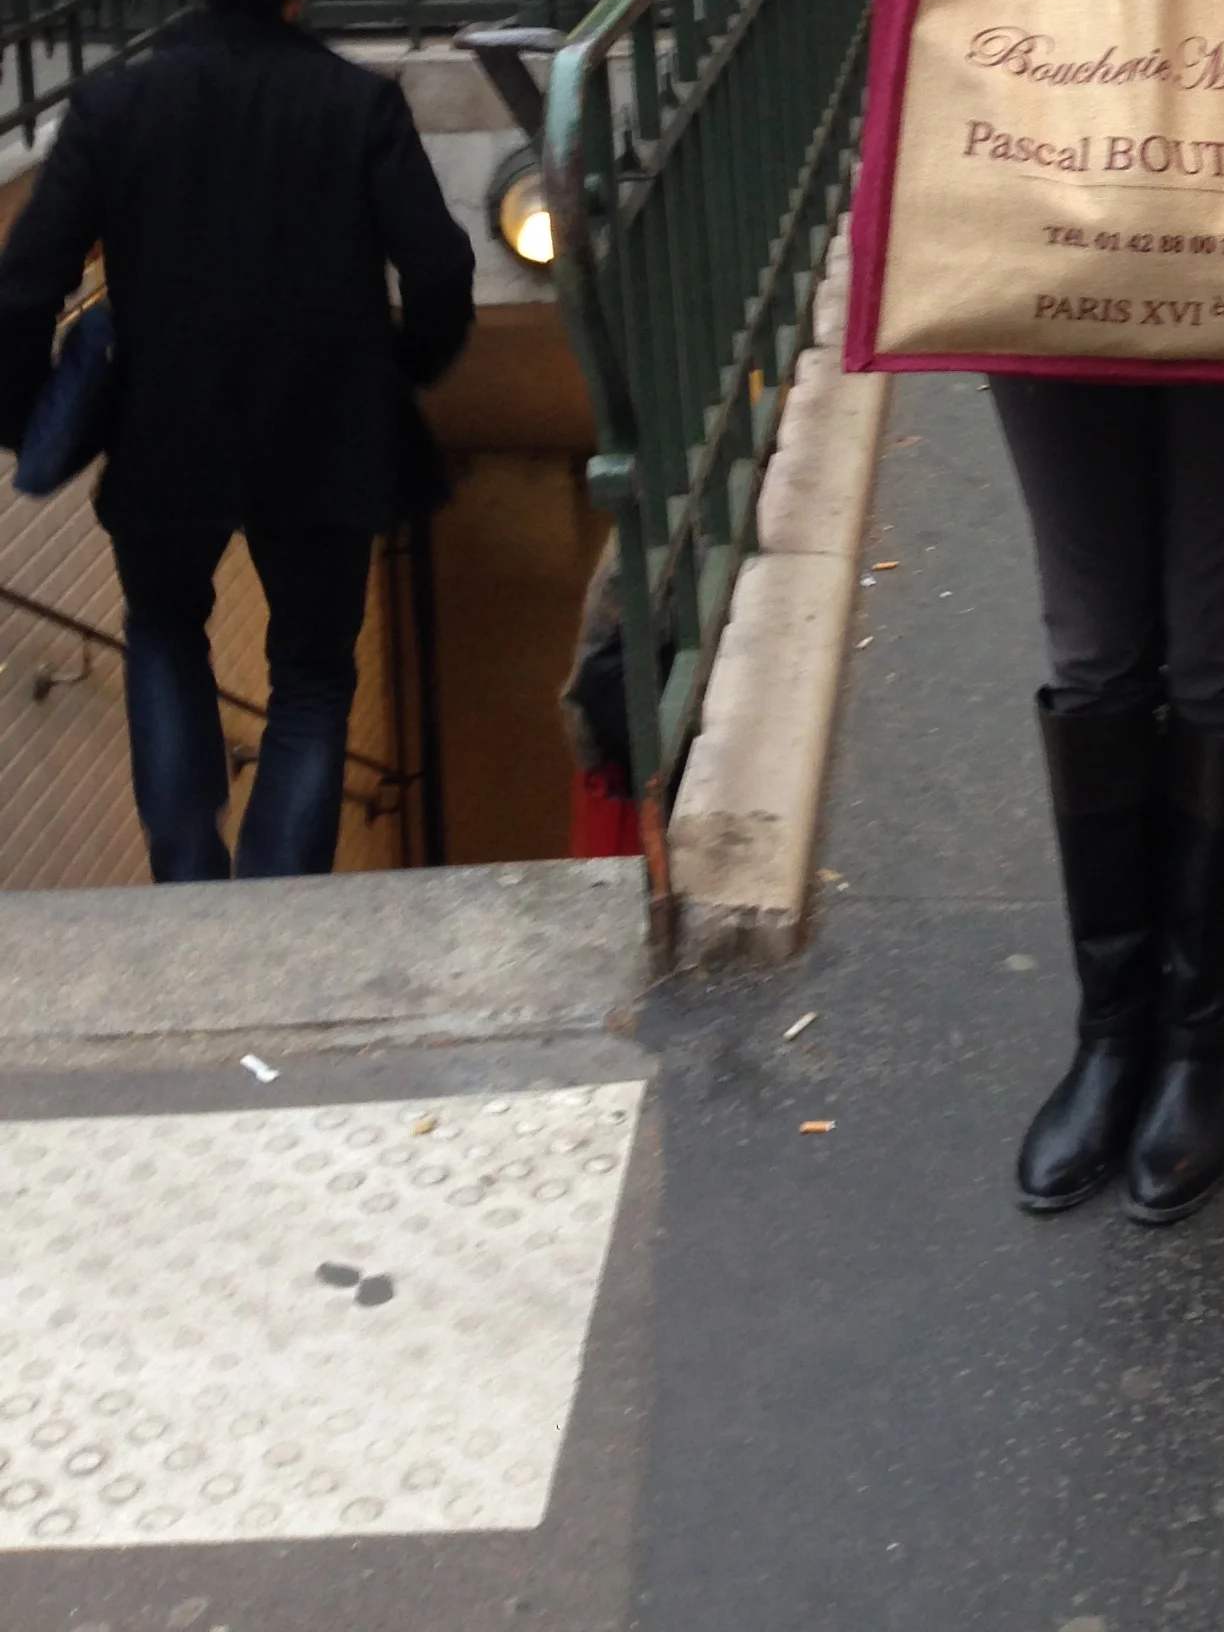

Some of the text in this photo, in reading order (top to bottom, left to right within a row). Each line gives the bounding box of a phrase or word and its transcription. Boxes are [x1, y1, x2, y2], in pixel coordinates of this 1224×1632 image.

[963, 119, 1092, 172] Pascal
[1034, 294, 1133, 323] PARIS
[1139, 300, 1205, 326] XVI
